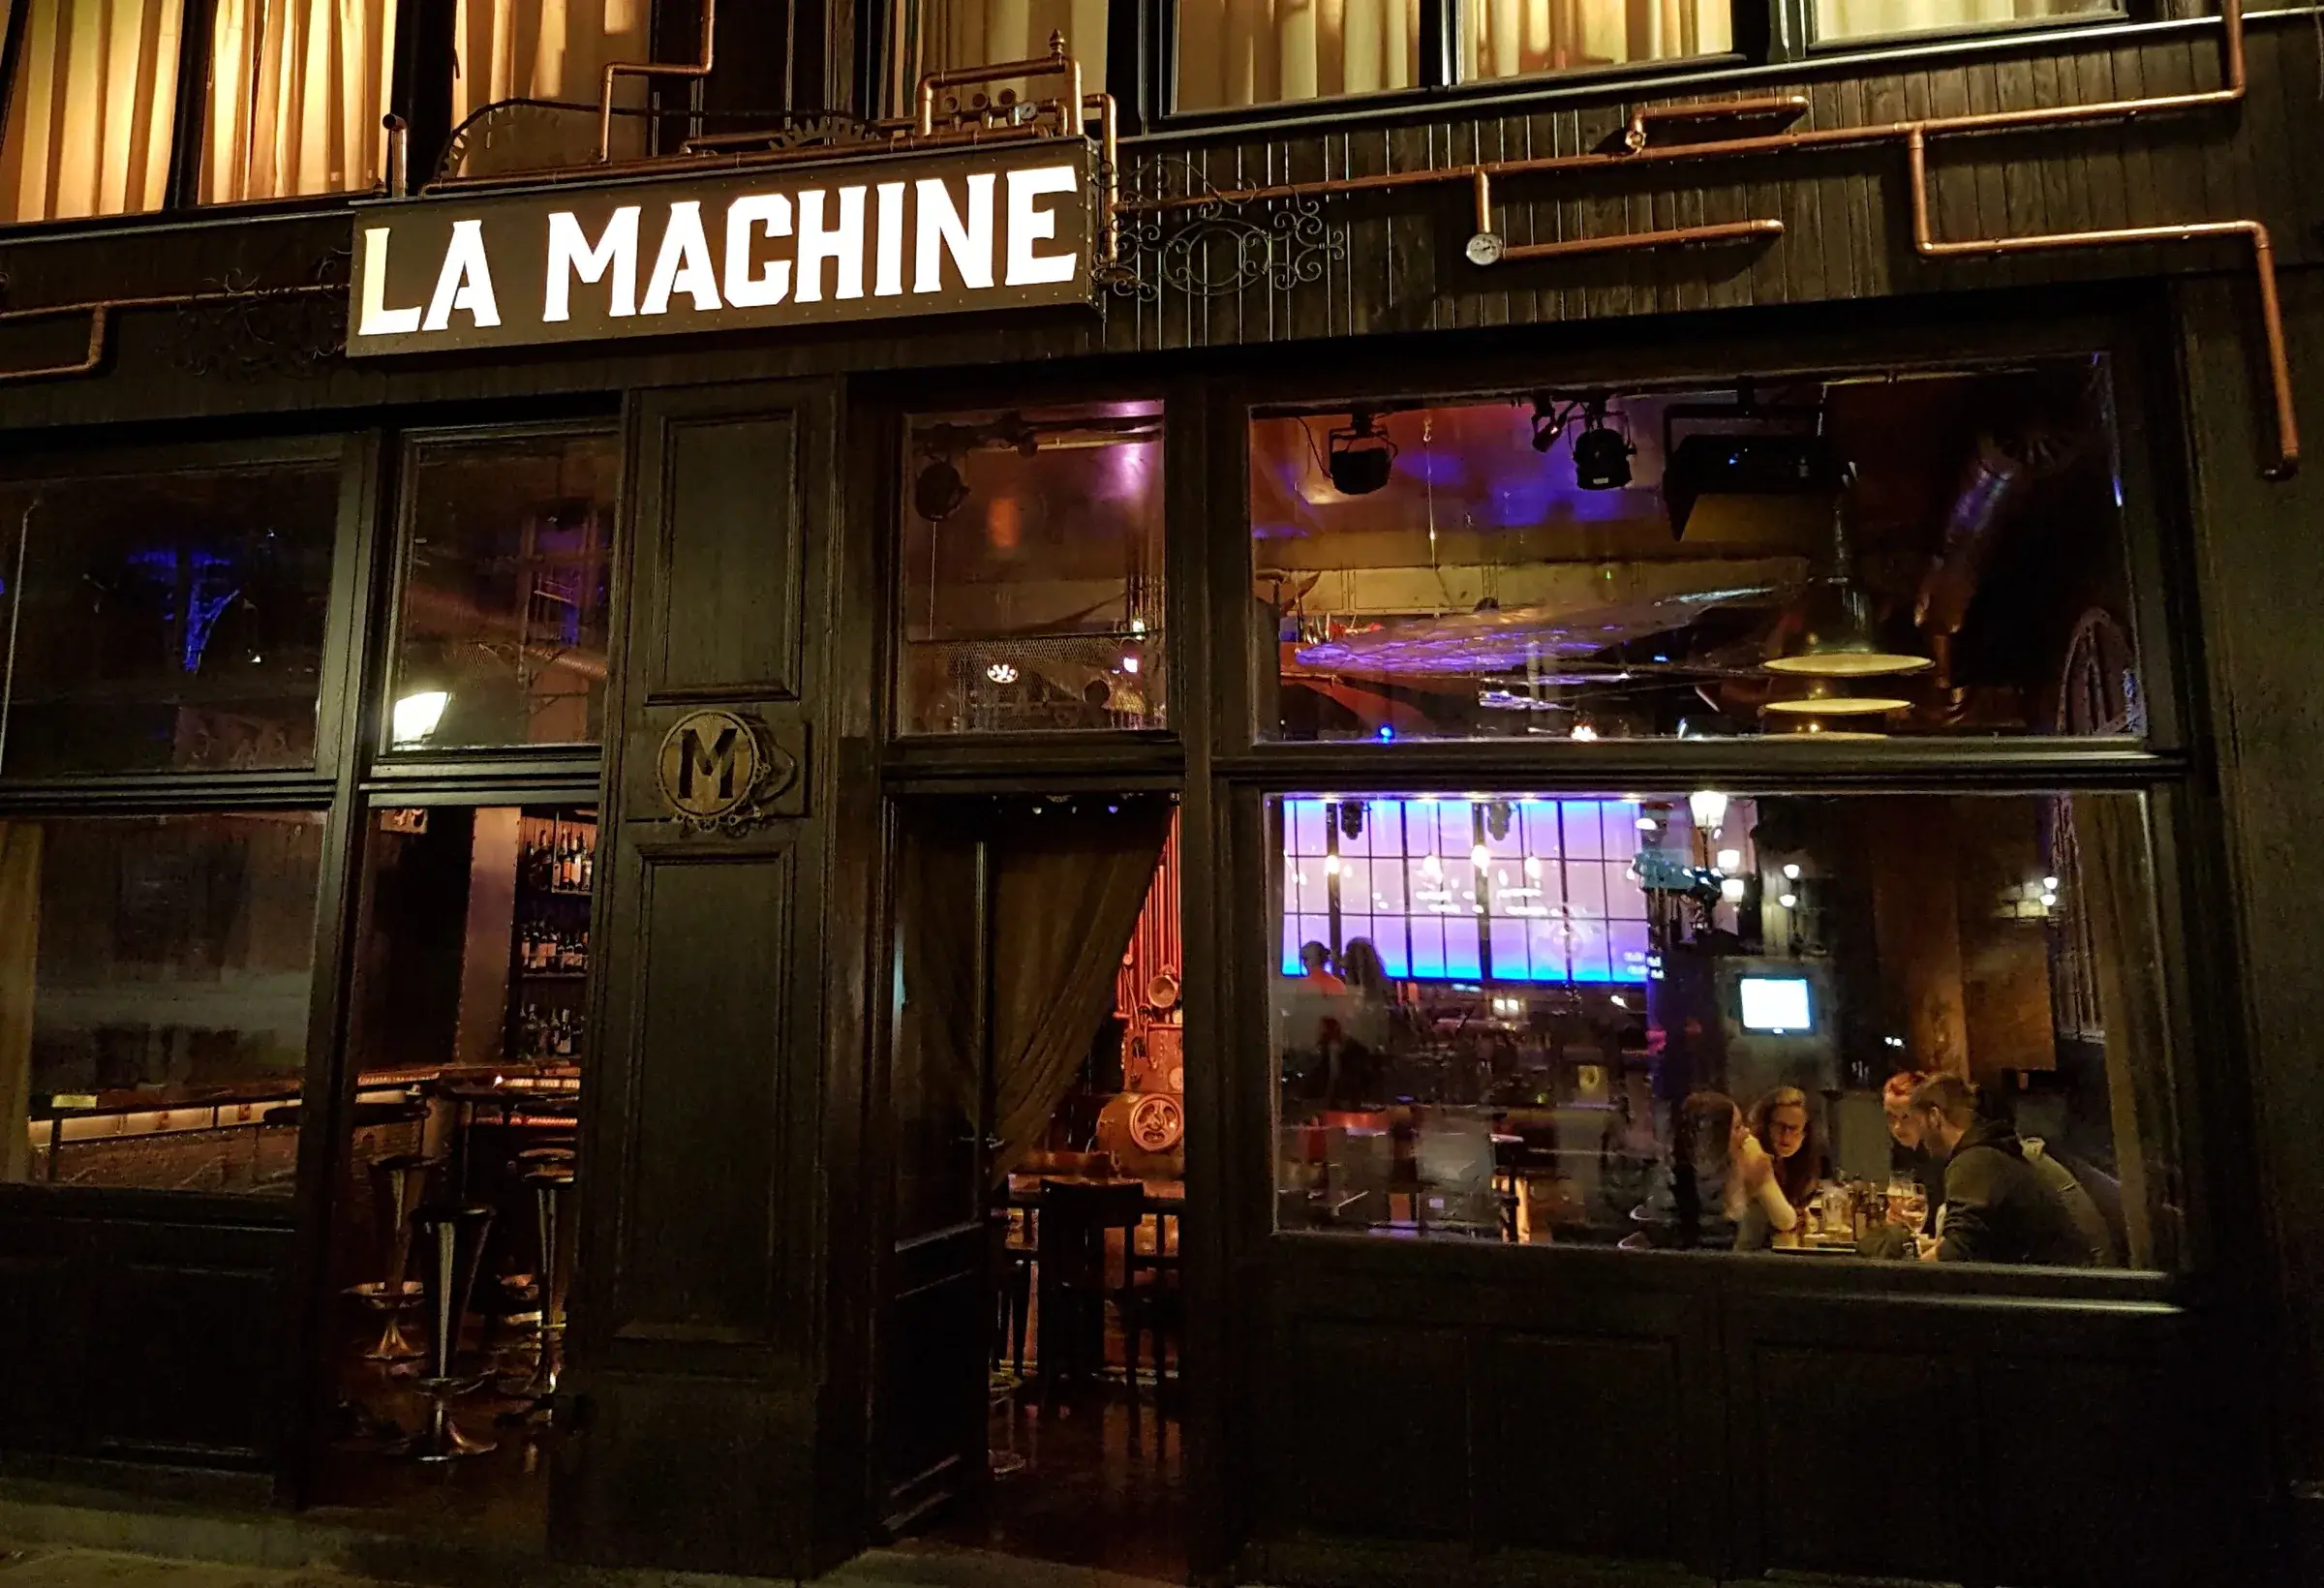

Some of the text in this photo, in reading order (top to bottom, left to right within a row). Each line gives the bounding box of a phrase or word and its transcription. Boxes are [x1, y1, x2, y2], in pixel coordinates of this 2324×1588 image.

[358, 165, 1078, 336] LA MACHINE
[678, 728, 737, 799] M
